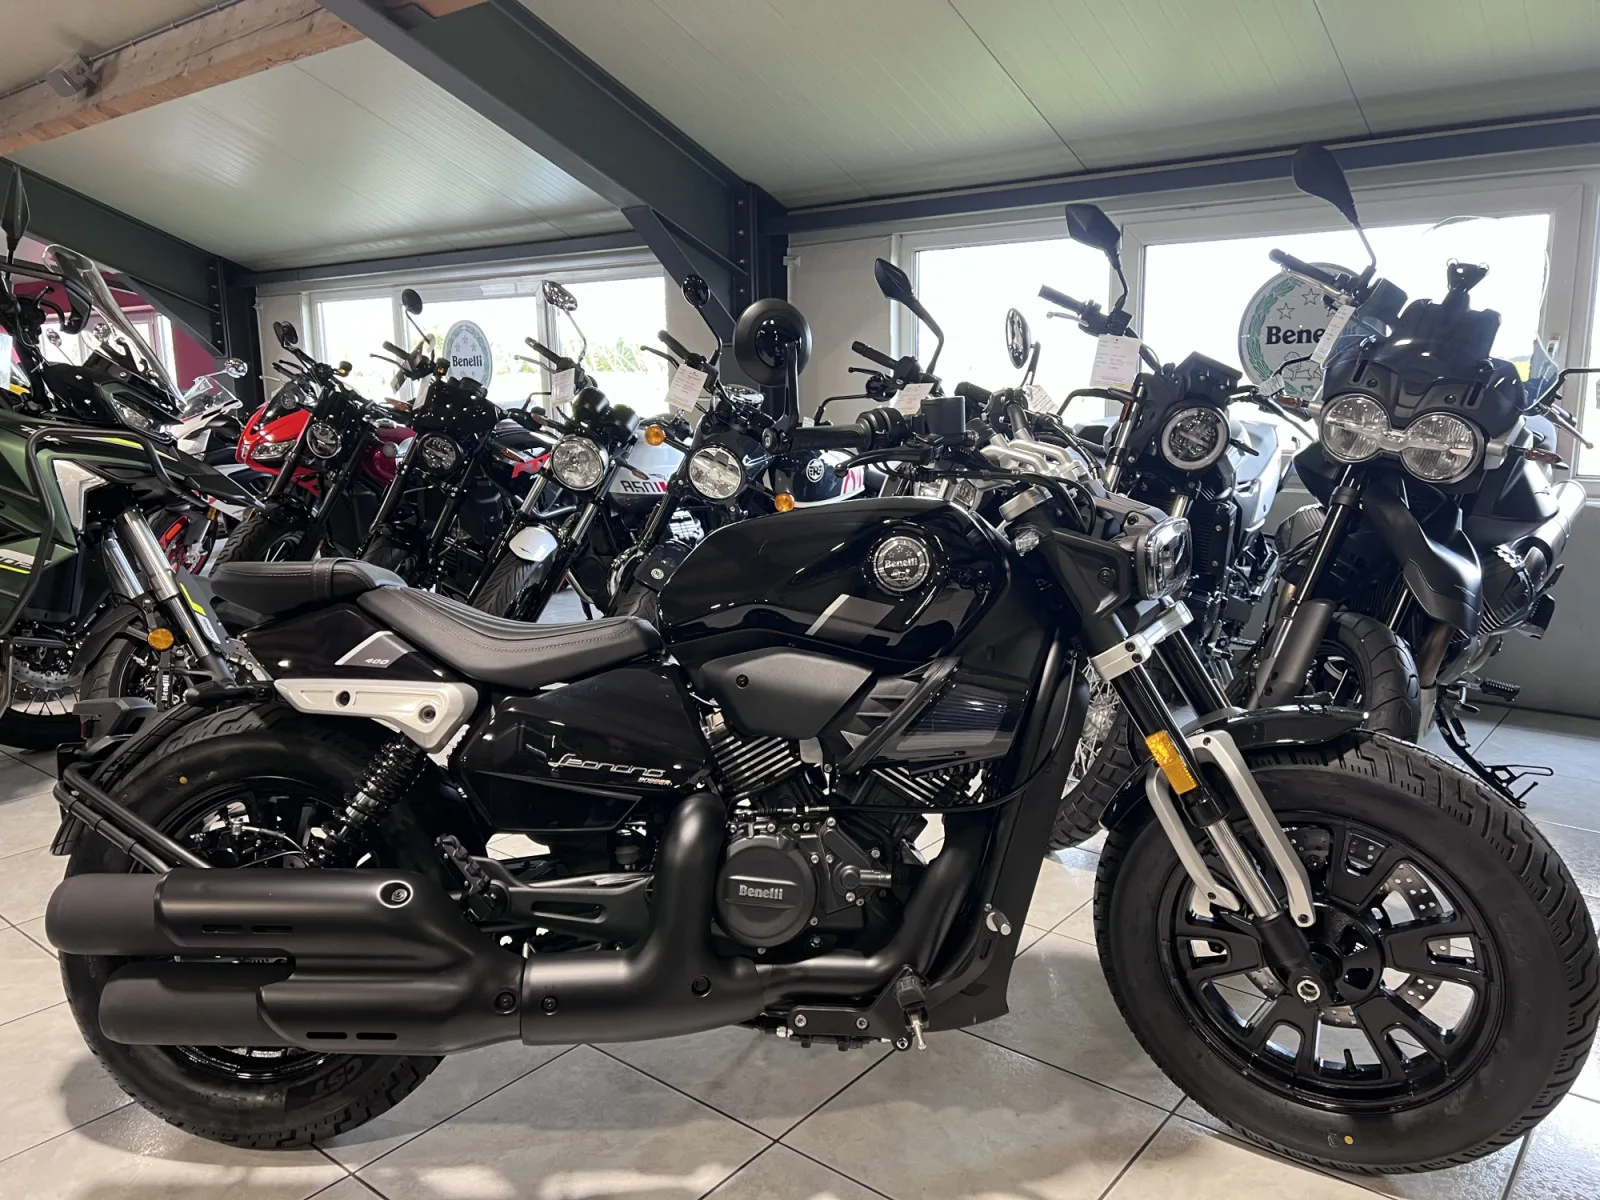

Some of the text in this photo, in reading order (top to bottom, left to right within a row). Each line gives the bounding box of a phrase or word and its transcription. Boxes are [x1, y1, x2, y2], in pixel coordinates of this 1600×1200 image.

[452, 355, 483, 367] Benelli
[884, 557, 918, 569] Benelli
[161, 674, 170, 701] Benelli
[548, 753, 666, 778] Leoncino
[738, 884, 783, 900] Benelli
